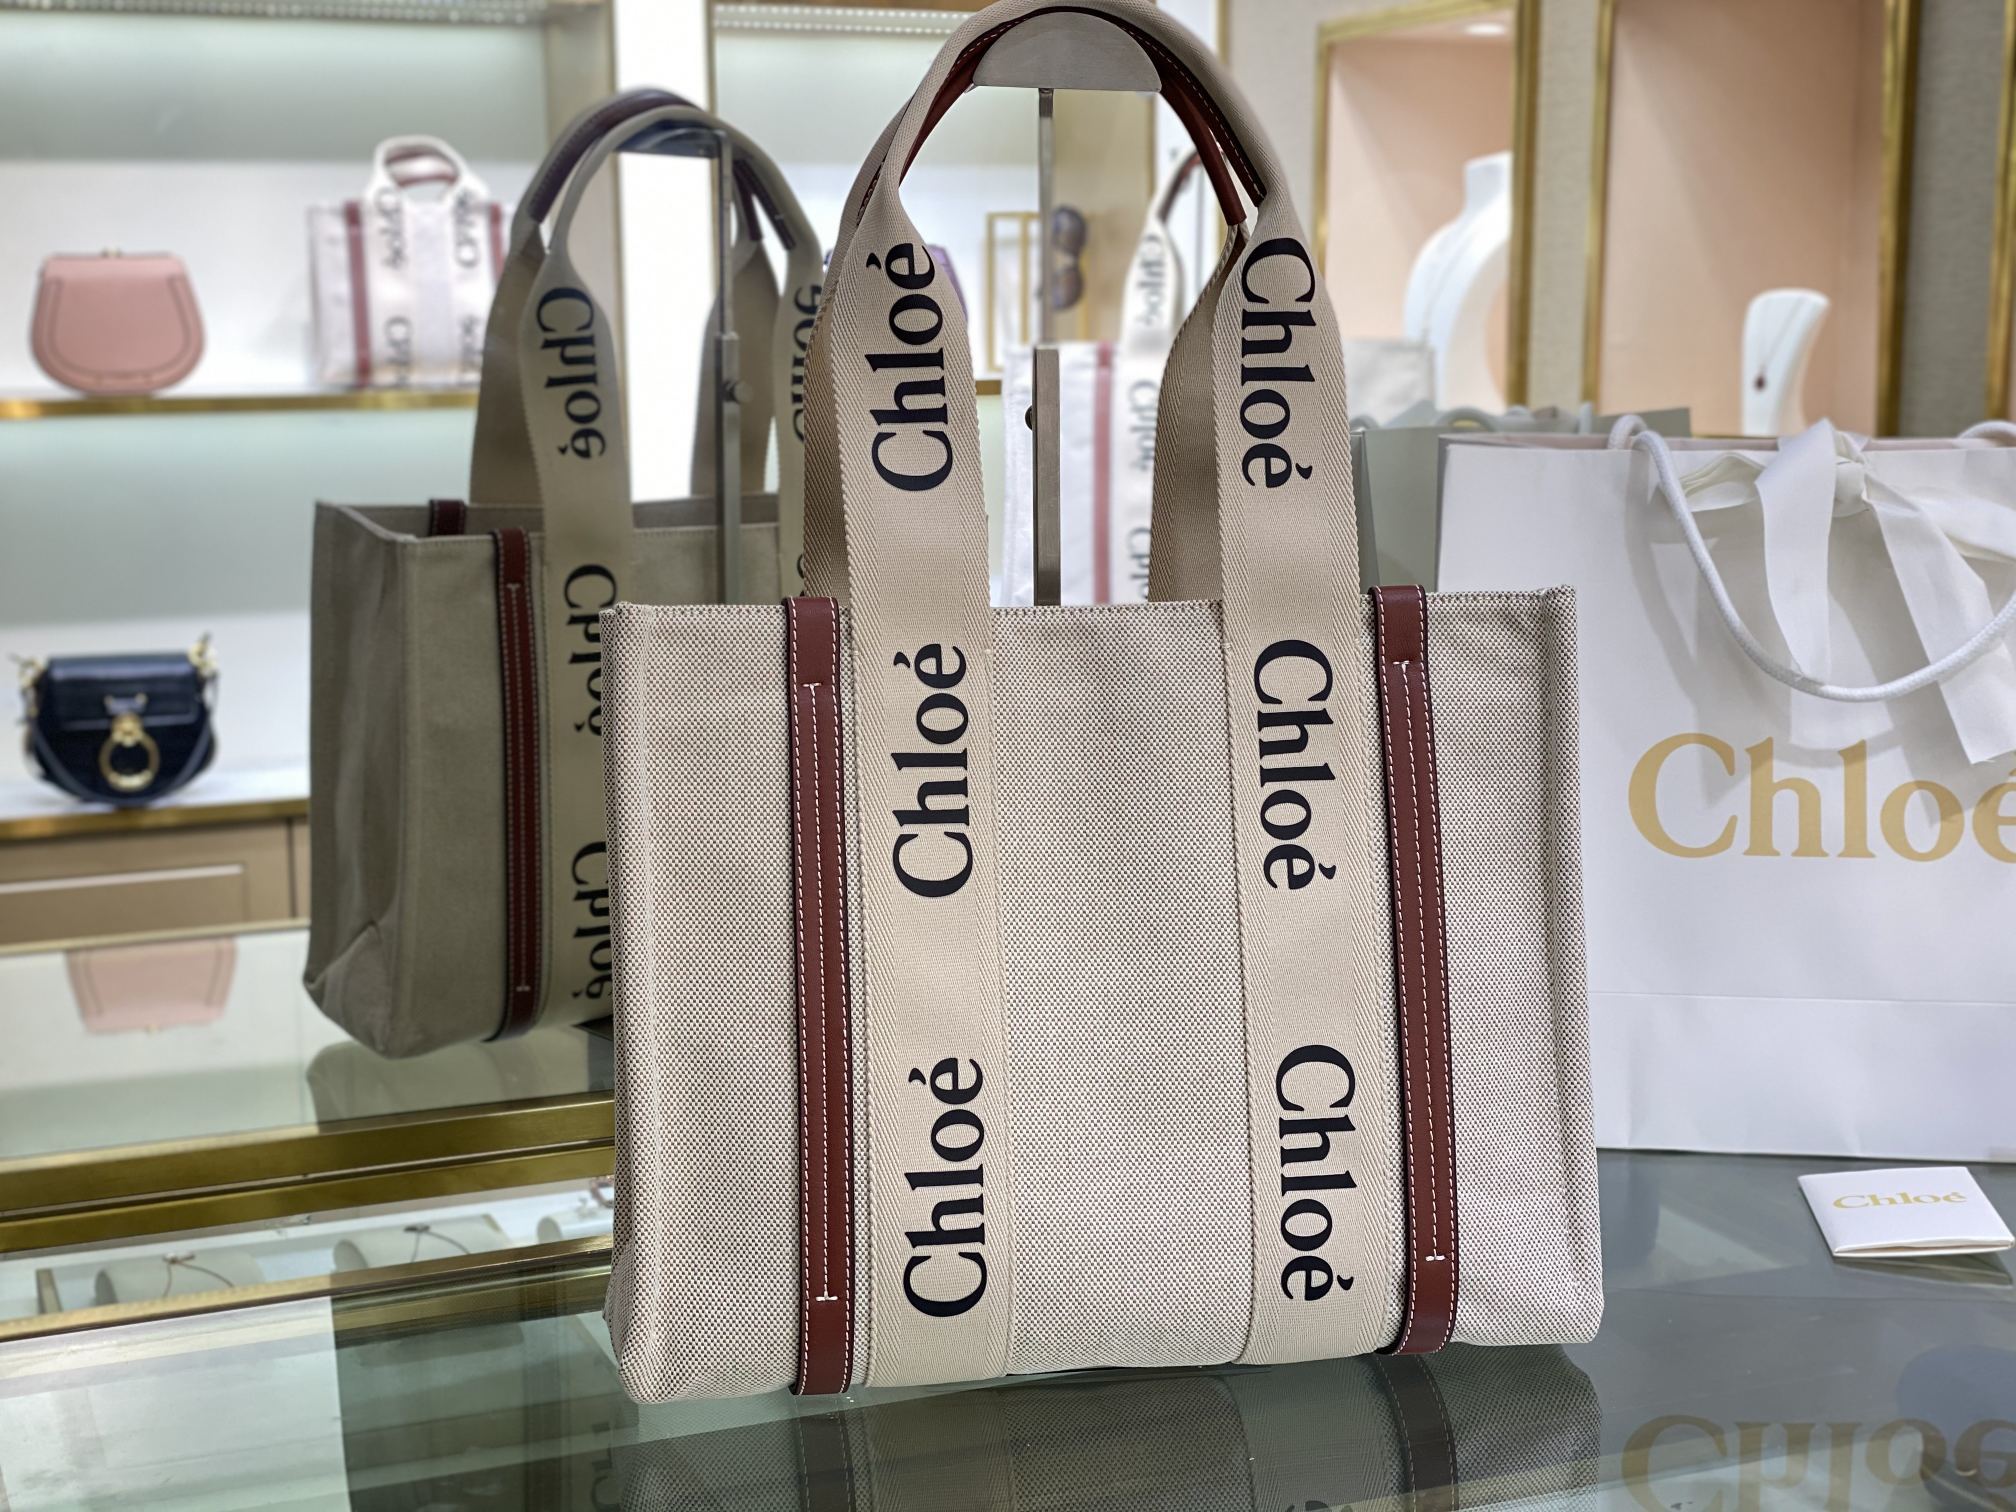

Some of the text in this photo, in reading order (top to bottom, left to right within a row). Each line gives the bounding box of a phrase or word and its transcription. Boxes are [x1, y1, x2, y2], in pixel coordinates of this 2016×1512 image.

[865, 242, 954, 491] Chloé
[1241, 237, 1317, 489] Chloé
[891, 643, 974, 898] Chloé
[1253, 639, 1337, 890] Chloé
[902, 1057, 988, 1318] Chloé
[1275, 1044, 1358, 1302] Chloé
[1833, 1191, 1967, 1208] Chloé
